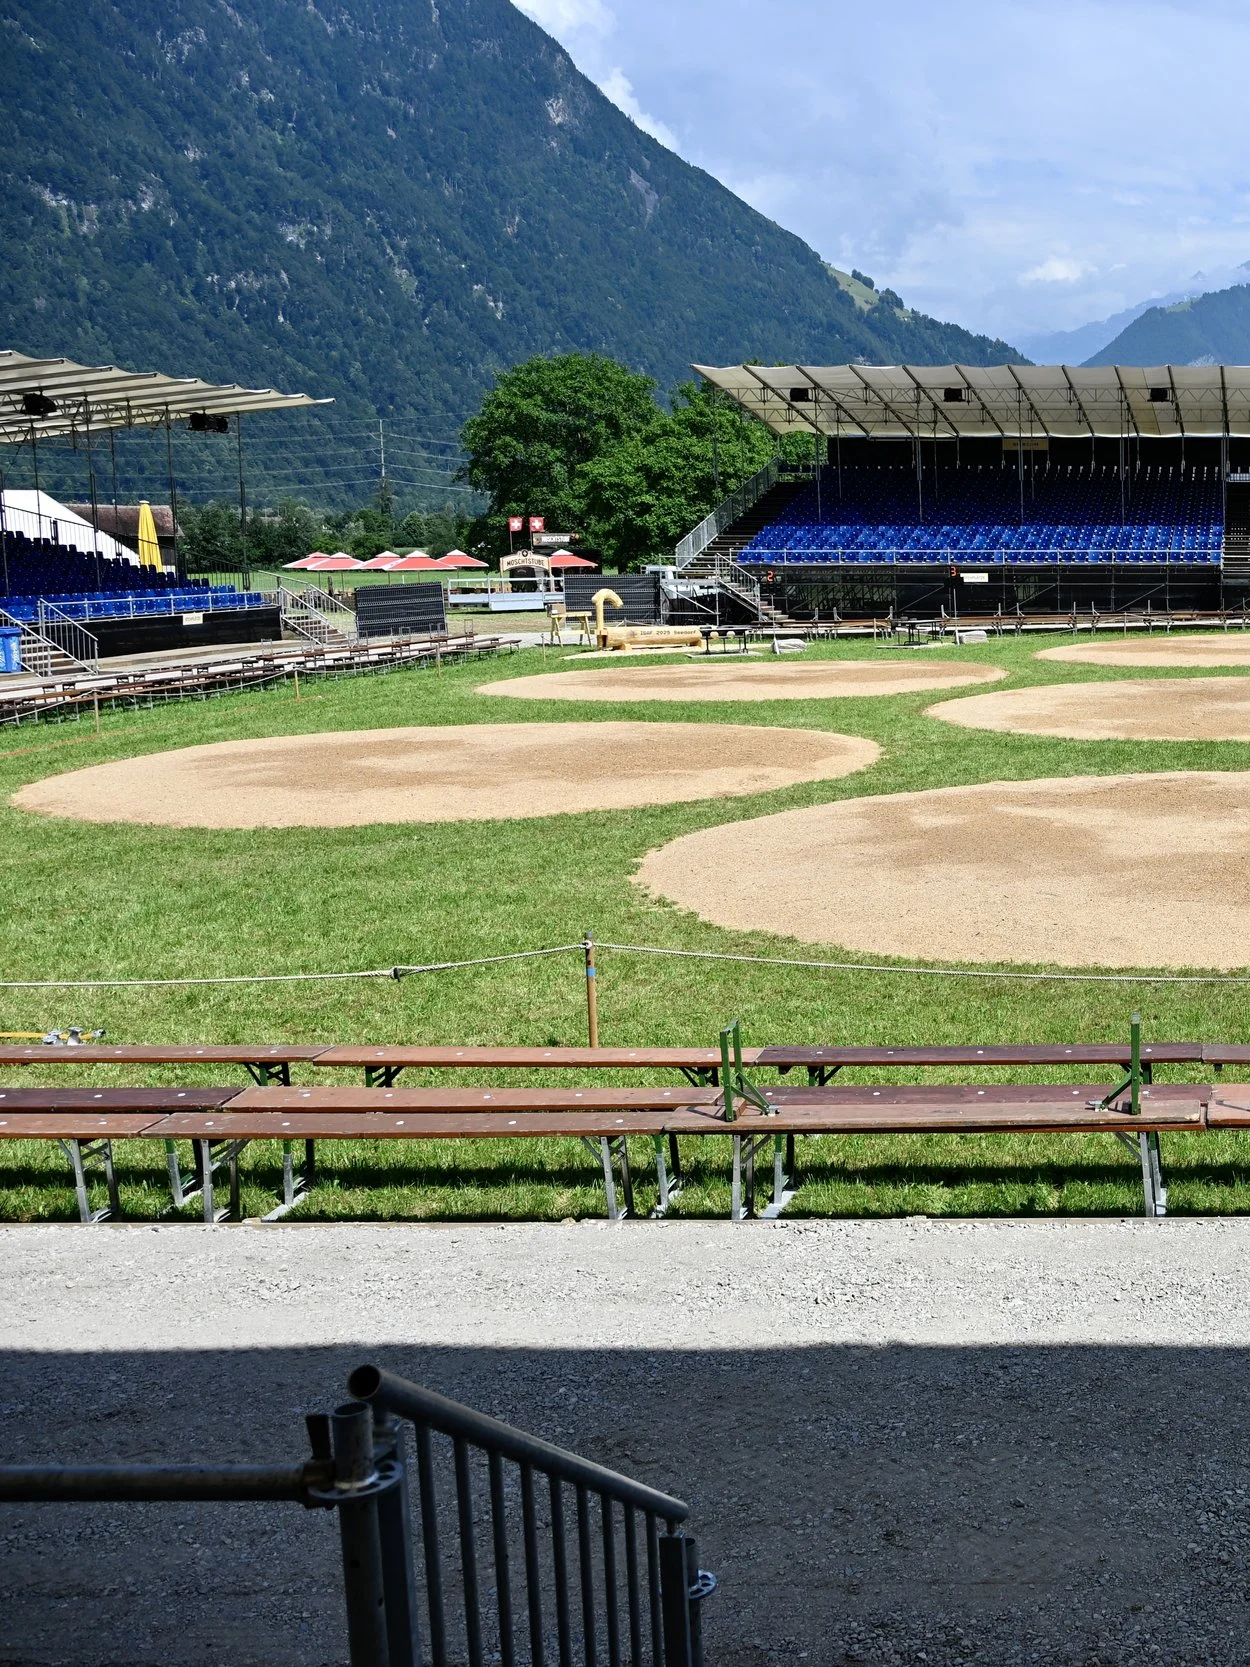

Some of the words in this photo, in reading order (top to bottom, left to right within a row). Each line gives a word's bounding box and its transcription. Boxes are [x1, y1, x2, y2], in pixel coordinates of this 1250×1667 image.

[506, 557, 545, 567] MOSCHTSTUBE
[767, 570, 774, 582] 2
[950, 566, 957, 577] 3
